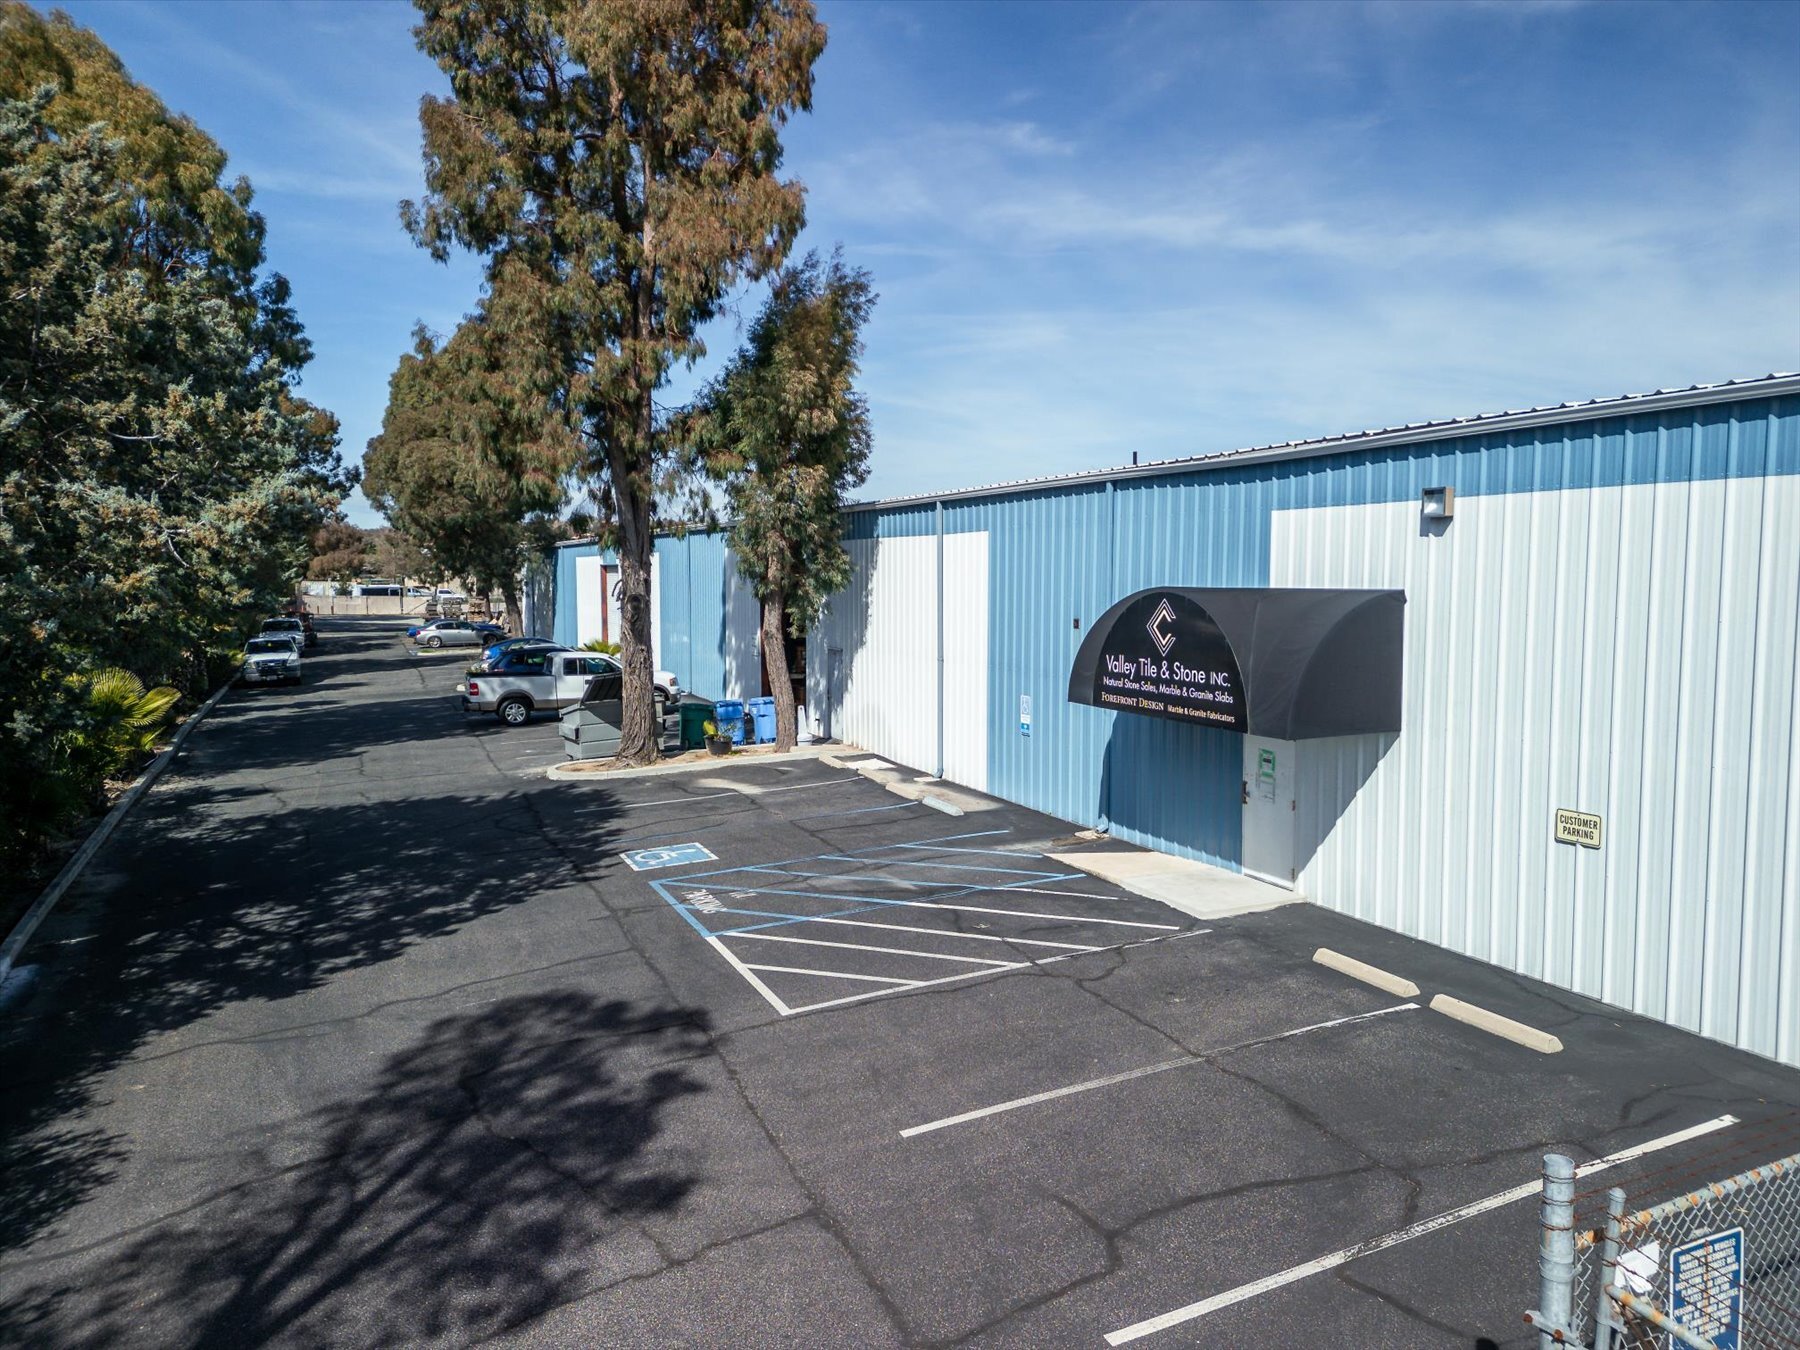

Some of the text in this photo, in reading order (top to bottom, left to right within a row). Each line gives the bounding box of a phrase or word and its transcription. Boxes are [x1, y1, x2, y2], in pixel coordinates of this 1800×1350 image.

[1105, 654, 1231, 687] Valley Tile & Stone INC.
[1103, 675, 1234, 704] Natural Stone Sales, Marble & Granite Slabs
[1101, 691, 1235, 723] FOREFRONT DESIGN Marble & Granite Fabricators
[1560, 815, 1598, 830] CUSTOMER
[1562, 826, 1594, 840] PARKING
